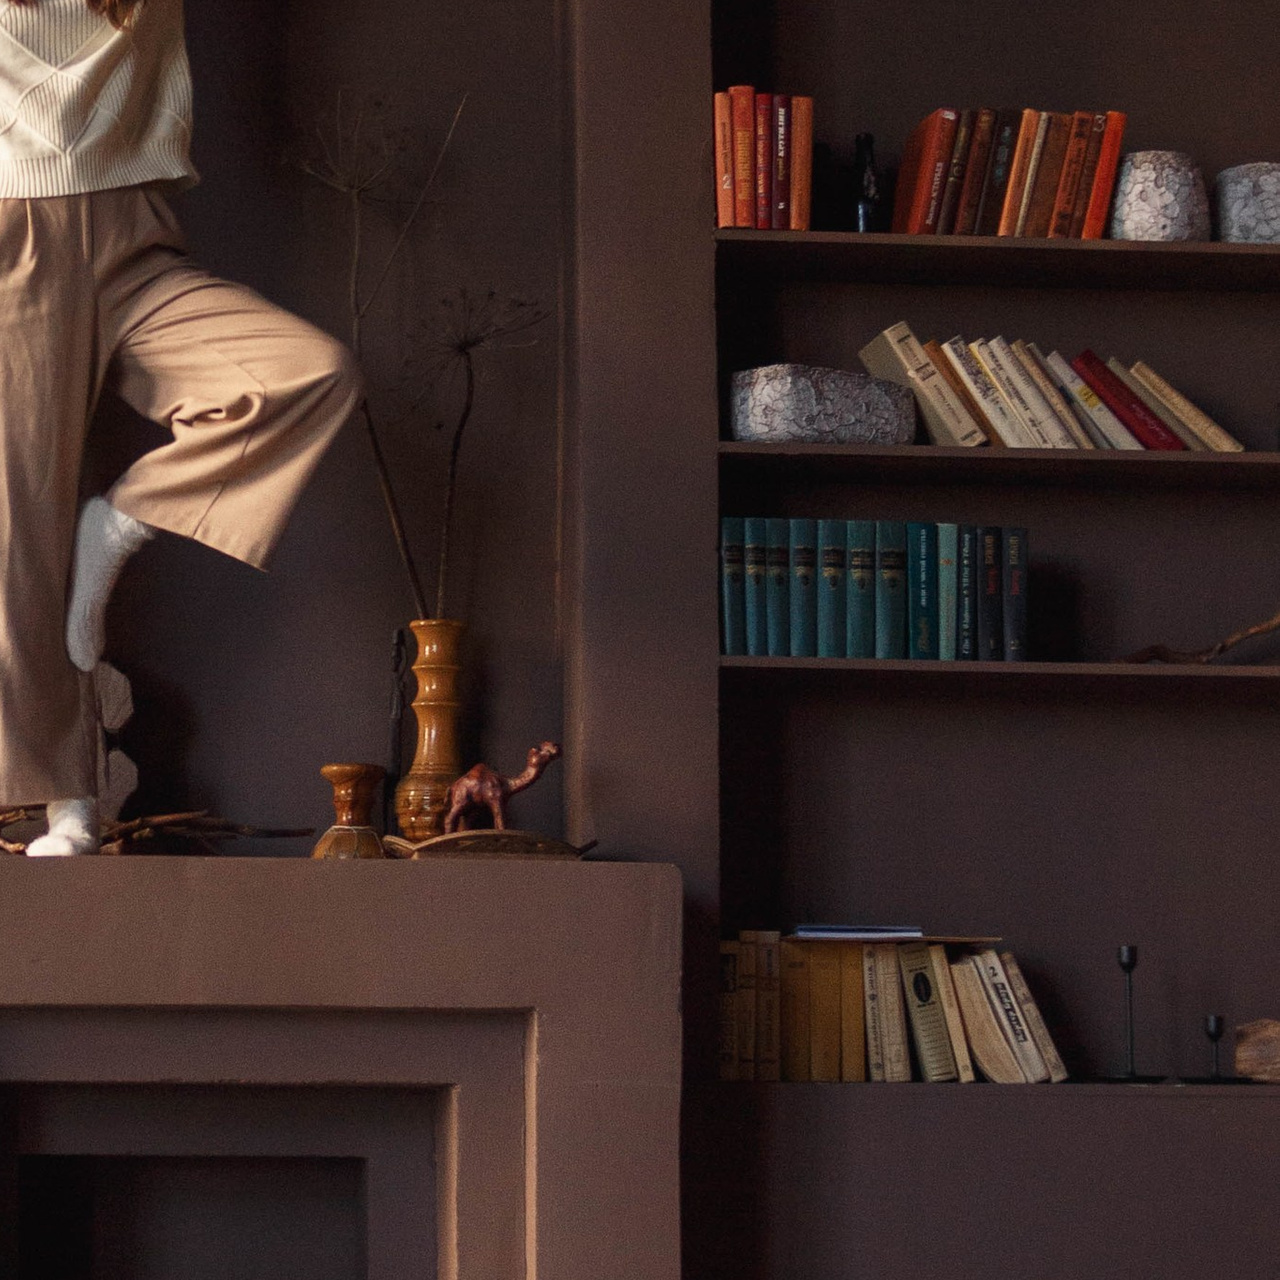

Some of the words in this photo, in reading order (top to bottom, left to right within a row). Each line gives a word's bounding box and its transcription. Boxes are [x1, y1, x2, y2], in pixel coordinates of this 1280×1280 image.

[1093, 114, 1105, 131] 3
[722, 175, 730, 188] 2
[989, 966, 997, 976] 2
